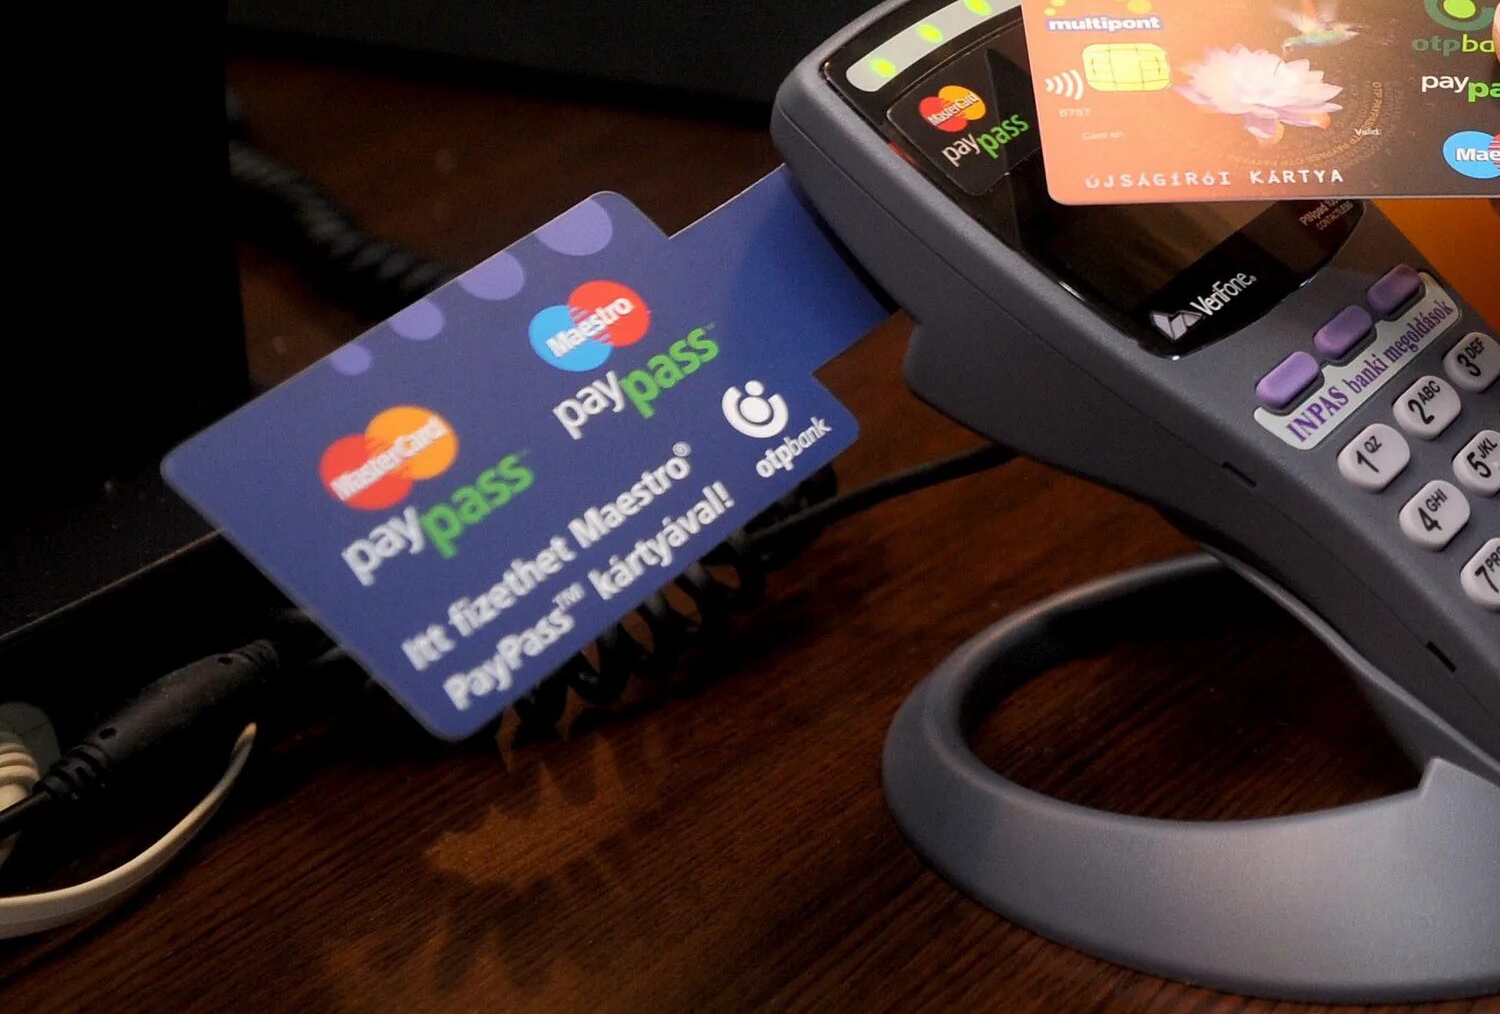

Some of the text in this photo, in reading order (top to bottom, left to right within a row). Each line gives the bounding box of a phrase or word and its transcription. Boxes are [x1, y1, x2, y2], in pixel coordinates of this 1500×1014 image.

[1047, 16, 1162, 32] multipont
[1411, 33, 1496, 57] otpba
[928, 92, 980, 127] MasterCard
[942, 113, 1030, 167] paypass
[1249, 168, 1344, 185] KÁRTYA
[546, 297, 635, 359] Maestro
[552, 326, 720, 441] paypass
[1286, 300, 1454, 443] INPAS banki megoldások
[755, 416, 833, 478] otpbank
[340, 454, 536, 587] paypass
[587, 480, 736, 601] kártyával!
[402, 623, 456, 672] Itt
[447, 535, 578, 637] fizethet
